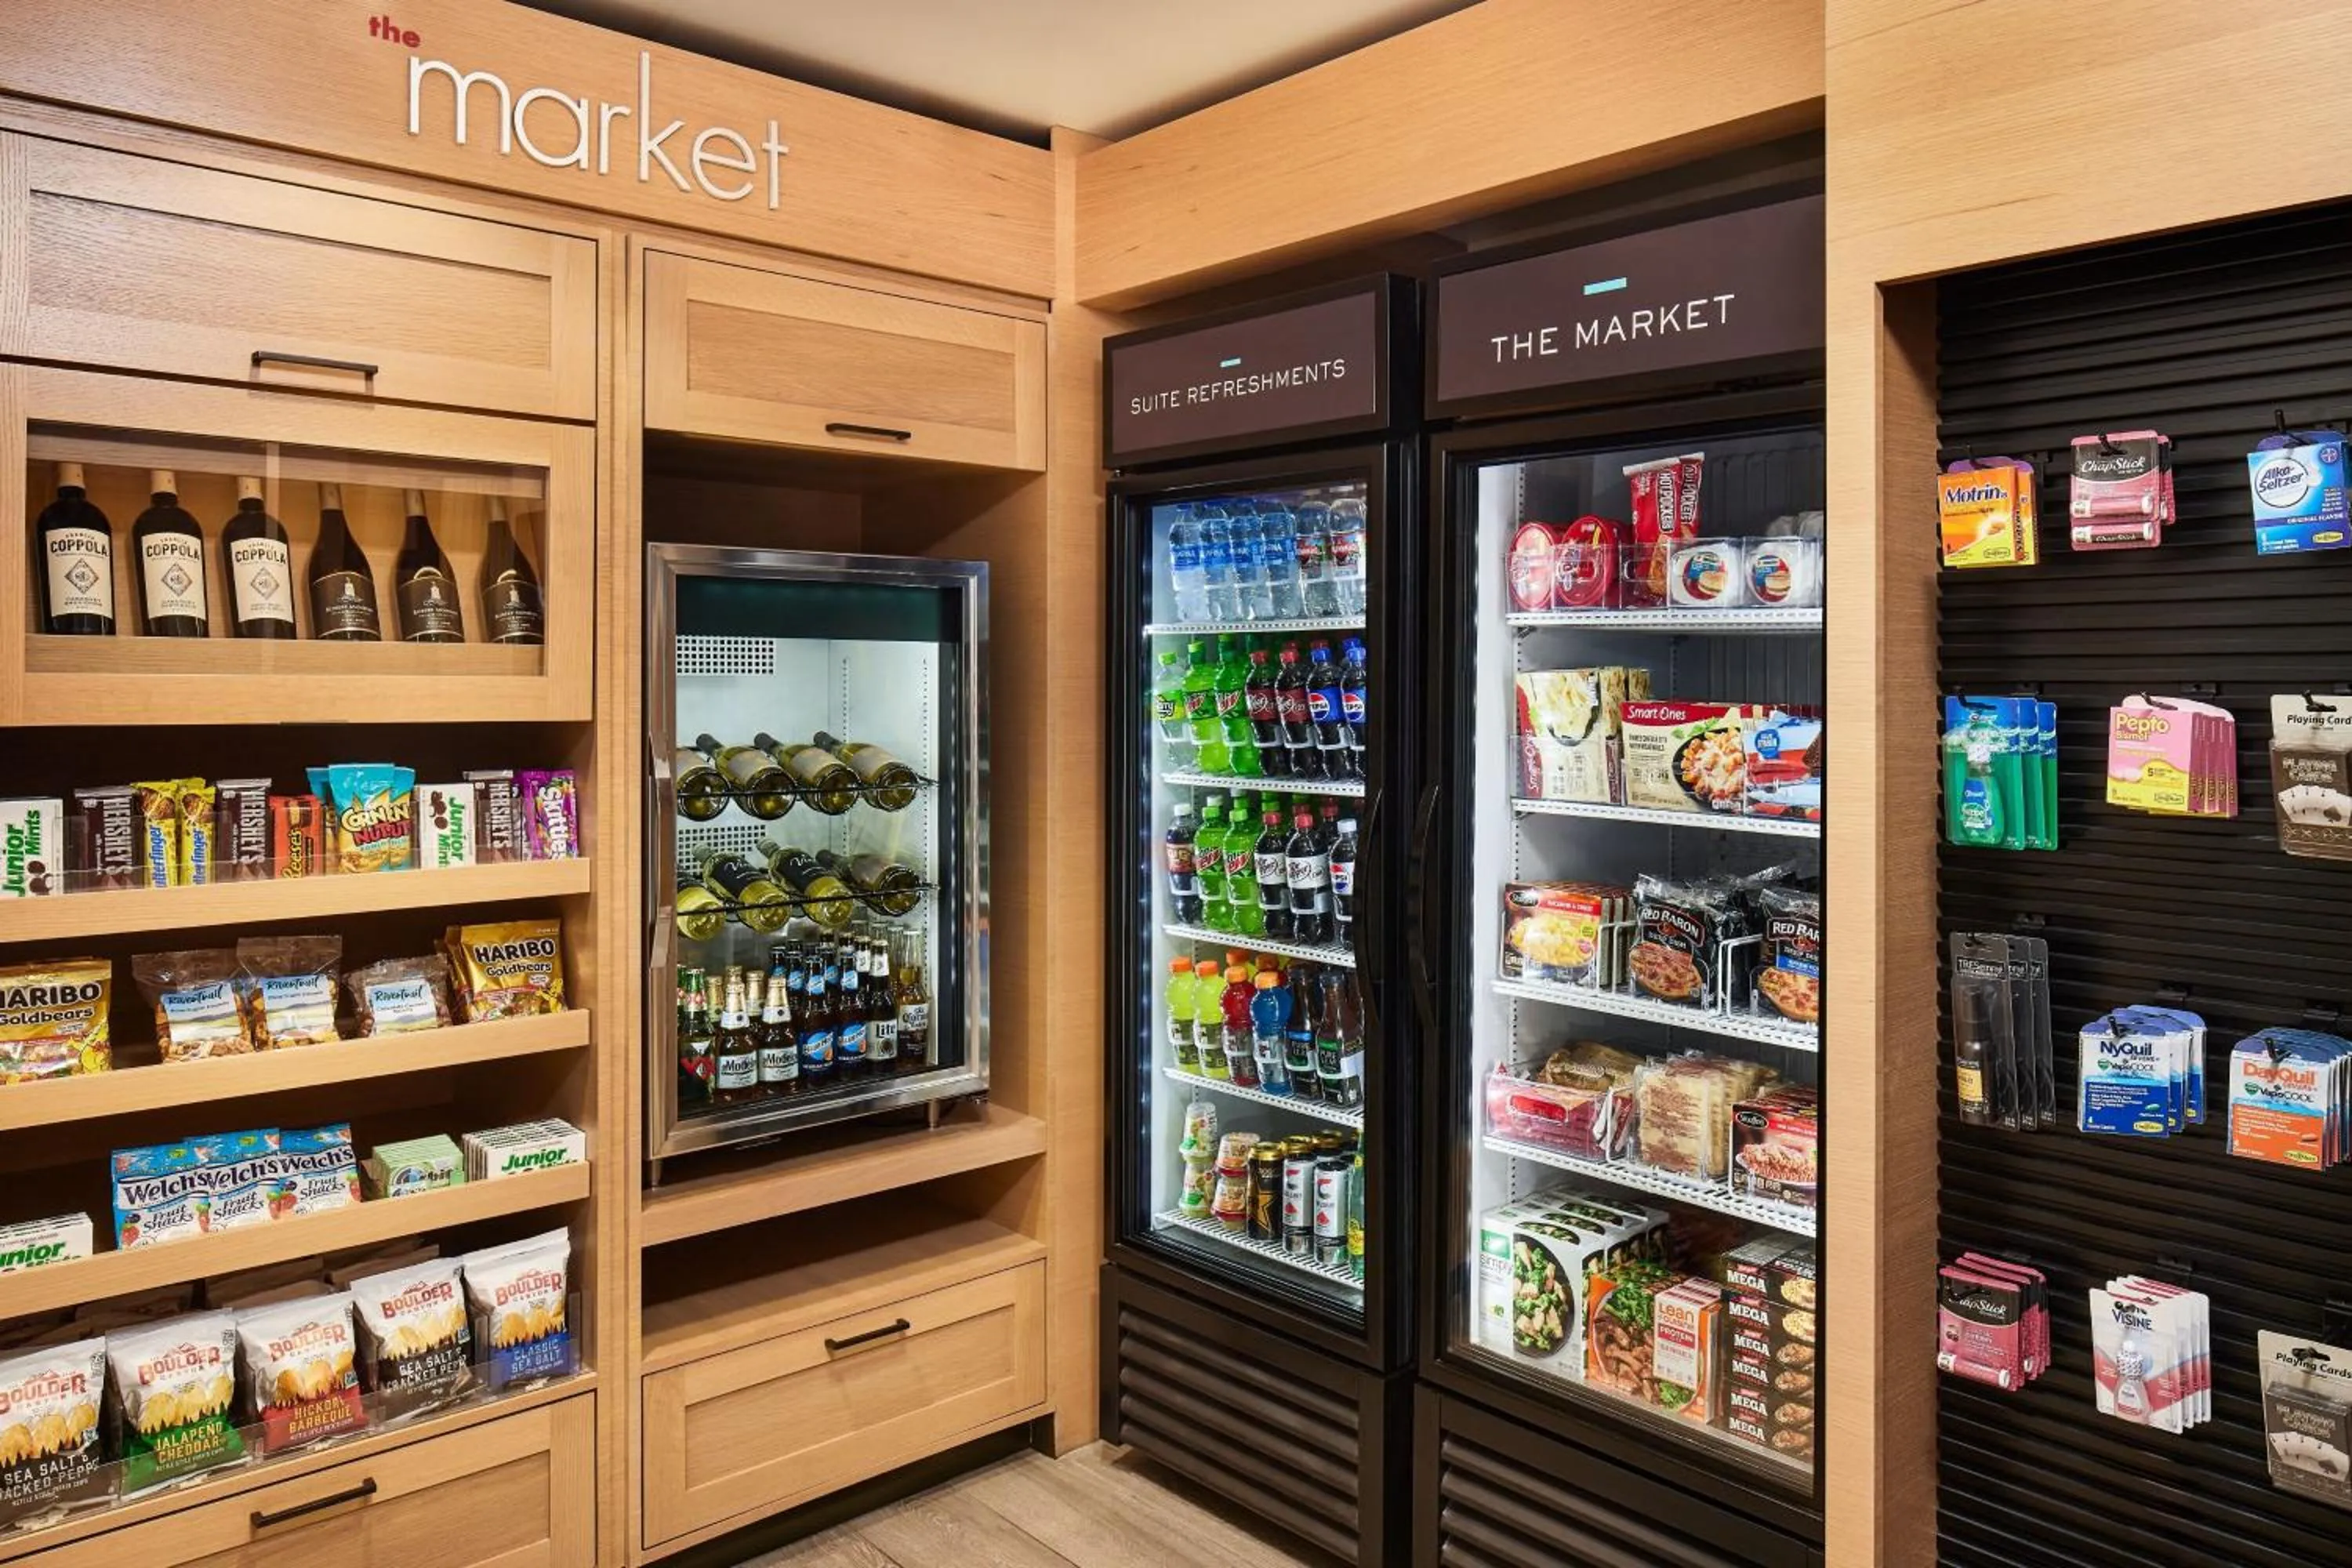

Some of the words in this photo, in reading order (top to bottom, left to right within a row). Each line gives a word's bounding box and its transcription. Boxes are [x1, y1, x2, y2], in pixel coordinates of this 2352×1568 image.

[368, 15, 421, 48] the
[408, 50, 789, 210] market
[1491, 326, 1559, 363] THE
[1576, 293, 1736, 350] MARKET
[1131, 390, 1181, 416] SUITE
[1187, 358, 1346, 405] REFRESHMENTS
[2082, 456, 2146, 473] ChapStick
[1945, 485, 2001, 503] Motrin
[2259, 472, 2303, 494] Seltzer
[49, 539, 108, 557] COPPOLA
[146, 543, 201, 561] COPPOLA
[234, 548, 287, 564] COPPOLA
[1628, 706, 1657, 719] Smart
[1659, 707, 1686, 720] Ones
[2115, 712, 2171, 734] Pepto
[2287, 714, 2325, 726] Playing
[2115, 731, 2149, 742] Bismol
[240, 786, 267, 864] HERSHEY'S
[488, 782, 514, 849] HERSHEY'S
[539, 786, 568, 860] Skittles
[25, 808, 42, 856] Mints
[448, 796, 466, 861] Junior
[1, 823, 26, 898] Junior
[1642, 908, 1661, 920] RED
[1661, 910, 1699, 938] BARON
[1773, 921, 1795, 934] RED
[474, 938, 555, 963] HARIBO
[486, 962, 552, 978] Goldbears
[2100, 1040, 2153, 1058] NyQuil
[2243, 1061, 2316, 1086] DayQuil
[501, 1147, 568, 1171] Junior
[123, 1171, 208, 1205] Welch's
[299, 1182, 347, 1201] Snacks
[307, 1176, 338, 1190] Fruit
[152, 1203, 187, 1221] Fruit
[212, 1200, 265, 1221] Snacks
[223, 1191, 258, 1210] Fruit
[143, 1212, 194, 1232] Snacks
[495, 1272, 562, 1306] BOULDER
[1726, 1269, 1767, 1294] MEGA
[380, 1281, 453, 1320] BOULDER
[1658, 1302, 1694, 1324] Lean
[1949, 1297, 2007, 1315] apStick
[1729, 1301, 1769, 1326] MEGA
[2111, 1308, 2152, 1330] VISINE
[268, 1323, 348, 1362] BOULDER
[1659, 1326, 1695, 1342] PROTEIN
[1733, 1333, 1770, 1357] MEGA
[138, 1345, 220, 1386] BOULDER
[399, 1360, 423, 1376] SEA
[426, 1349, 452, 1368] SALT
[1731, 1359, 1769, 1385] MEGA
[2276, 1352, 2318, 1370] Playing
[2320, 1363, 2352, 1379] Cards
[1730, 1392, 1769, 1417] MEGA
[289, 1406, 352, 1434] BARBEQUE
[1729, 1416, 1766, 1442] MEGA
[158, 1435, 220, 1463] CHEDDAR
[4, 1467, 34, 1485] SEA
[40, 1454, 77, 1476] SALT
